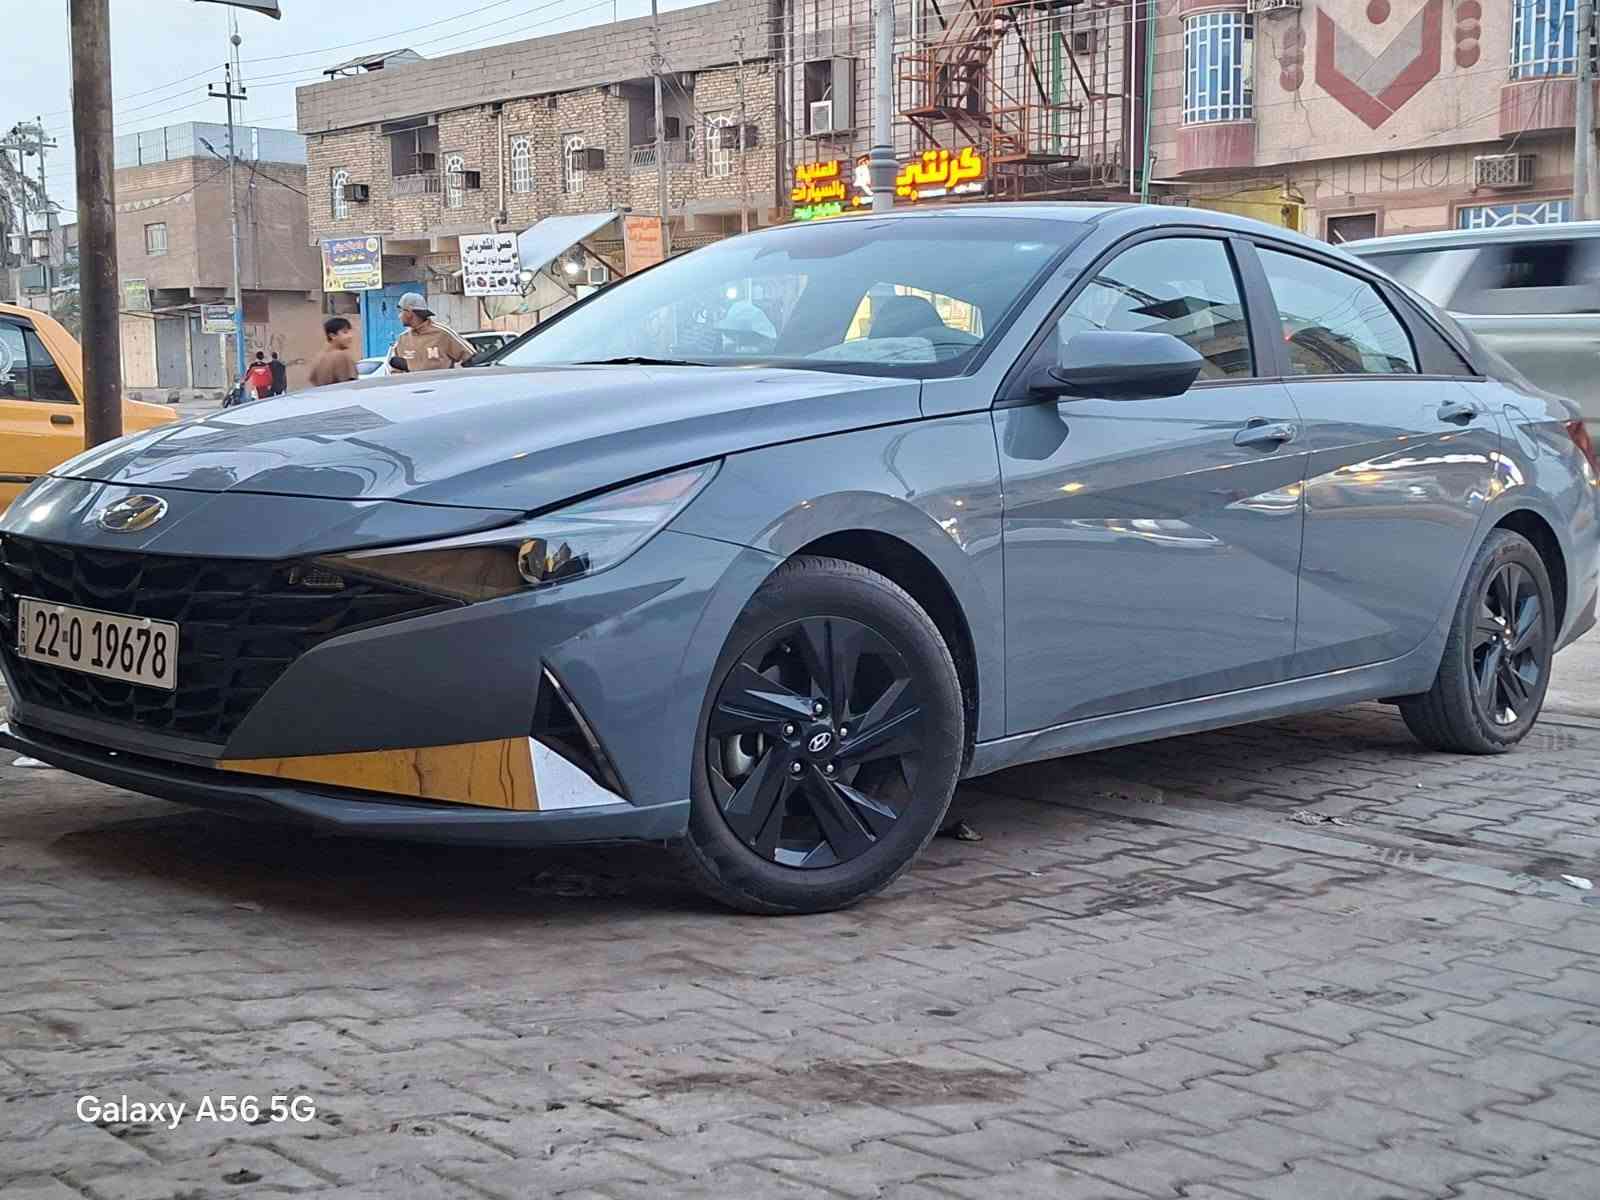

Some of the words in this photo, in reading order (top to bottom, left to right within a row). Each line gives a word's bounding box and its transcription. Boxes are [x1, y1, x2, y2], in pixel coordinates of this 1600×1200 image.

[791, 180, 845, 202] بالسيارات
[35, 610, 60, 657] 22
[91, 621, 166, 679] 19678
